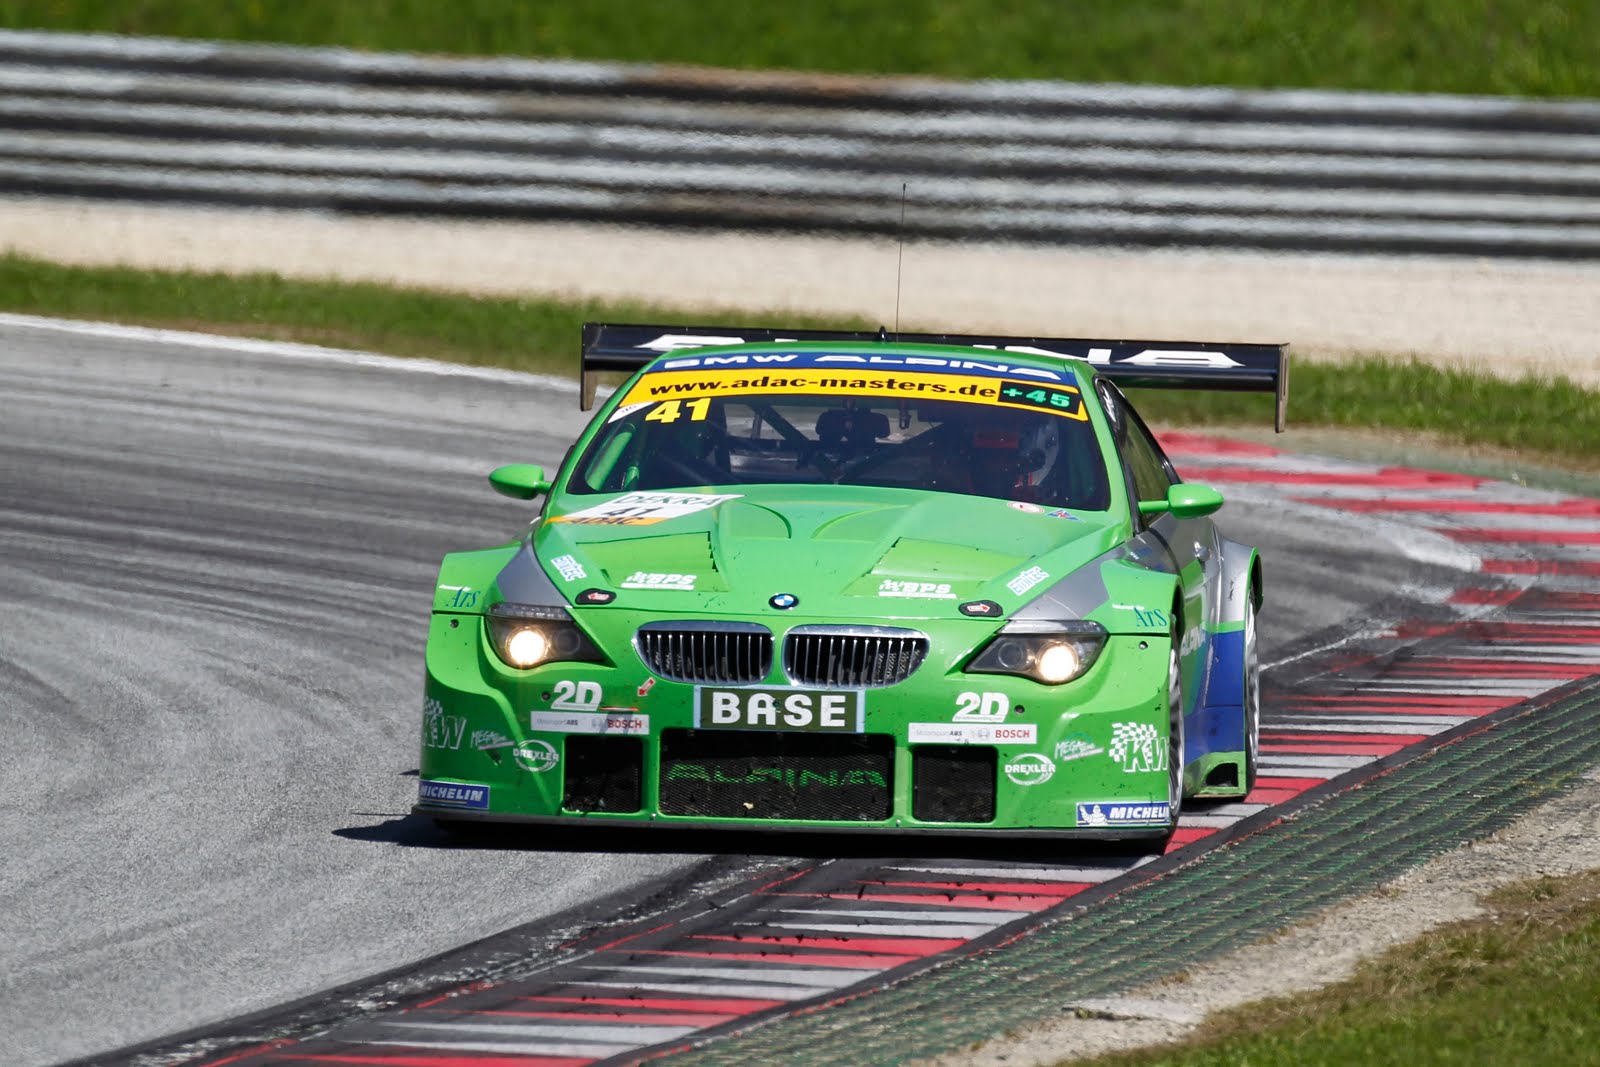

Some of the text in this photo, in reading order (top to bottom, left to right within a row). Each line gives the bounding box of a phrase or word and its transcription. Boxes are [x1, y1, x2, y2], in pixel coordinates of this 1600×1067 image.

[664, 355, 1061, 380] BMW ALPINA
[650, 376, 997, 397] www.adac-masters.de
[1003, 388, 1070, 408] +45
[645, 398, 711, 423] 41
[613, 495, 725, 506] DEKRA
[601, 506, 664, 517] 41
[550, 680, 602, 711] 2D
[712, 691, 847, 727] BASE
[952, 692, 1009, 722] 2D
[607, 719, 642, 729] BOSCH
[995, 729, 1030, 739] BOSCH
[512, 748, 559, 762] DREXLER
[667, 763, 888, 788] ALPINA
[1004, 763, 1056, 775] DREXLER
